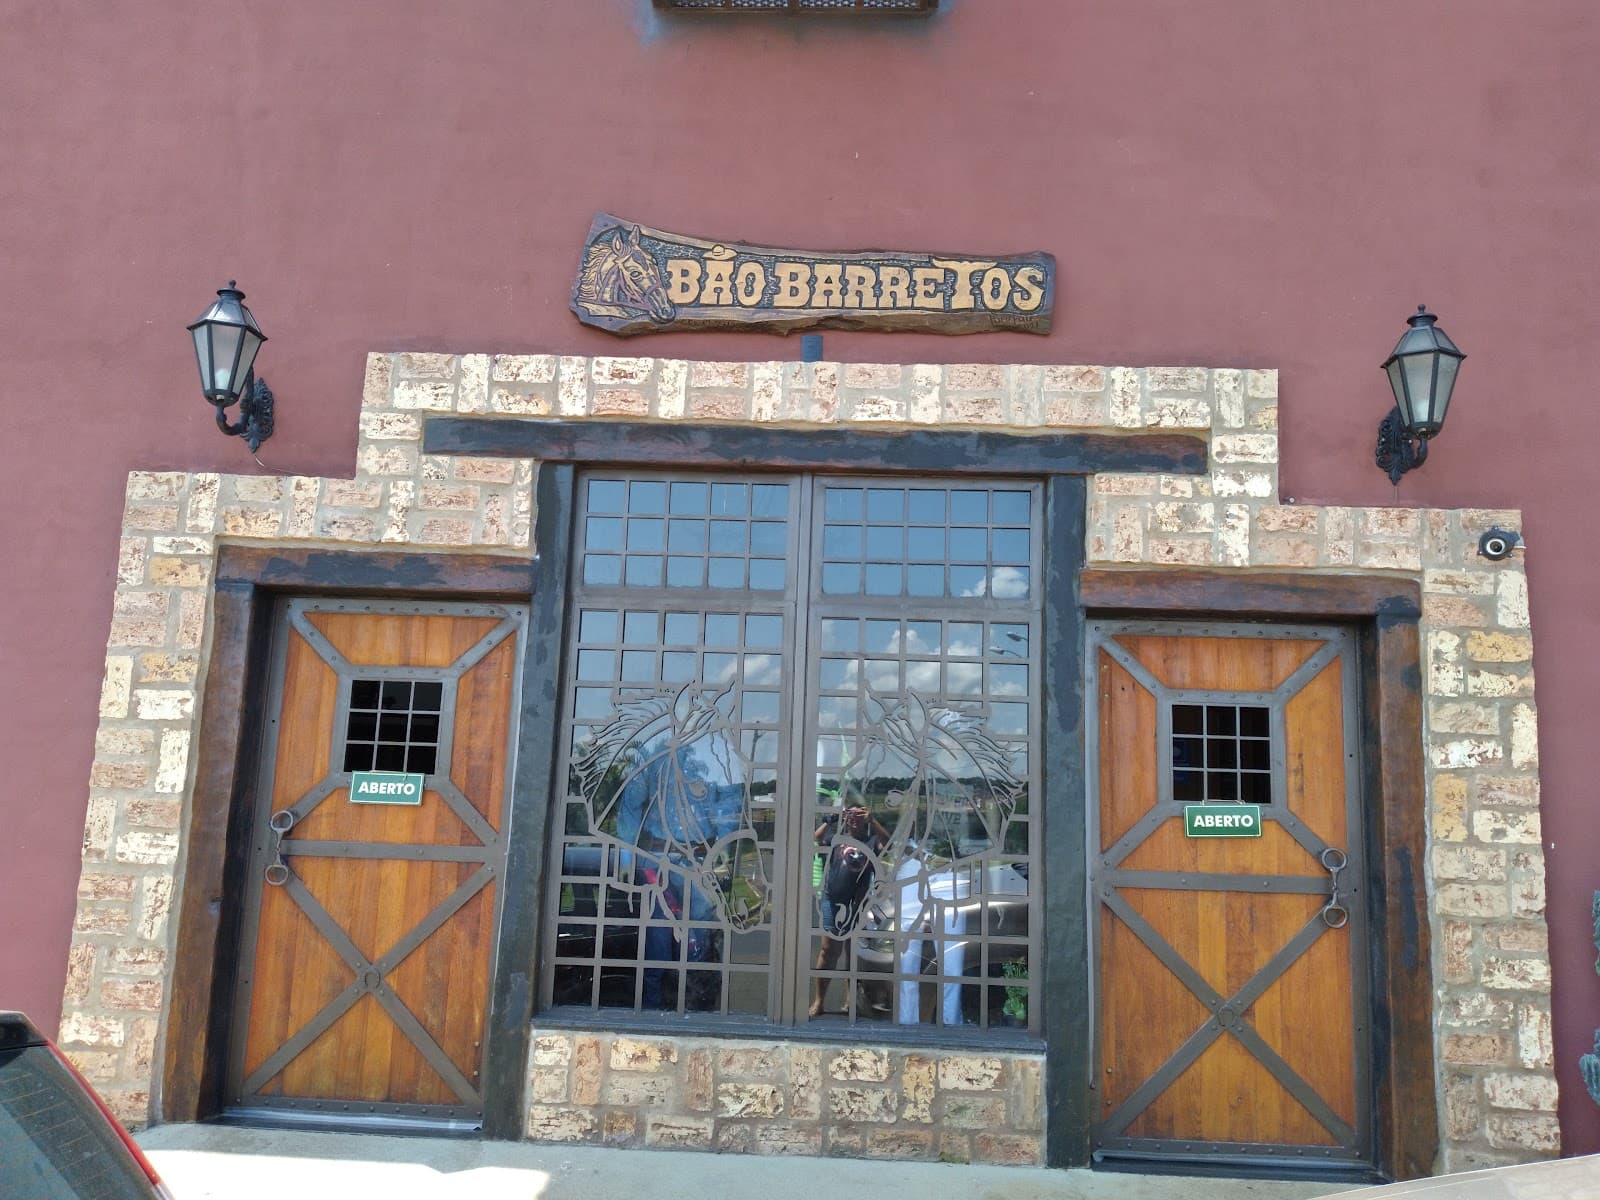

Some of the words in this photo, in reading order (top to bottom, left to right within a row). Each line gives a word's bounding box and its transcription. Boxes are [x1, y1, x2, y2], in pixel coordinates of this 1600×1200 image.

[773, 259, 1045, 311] BARRETOS
[358, 781, 416, 796] ABERTO
[1193, 814, 1254, 828] ABERTO
